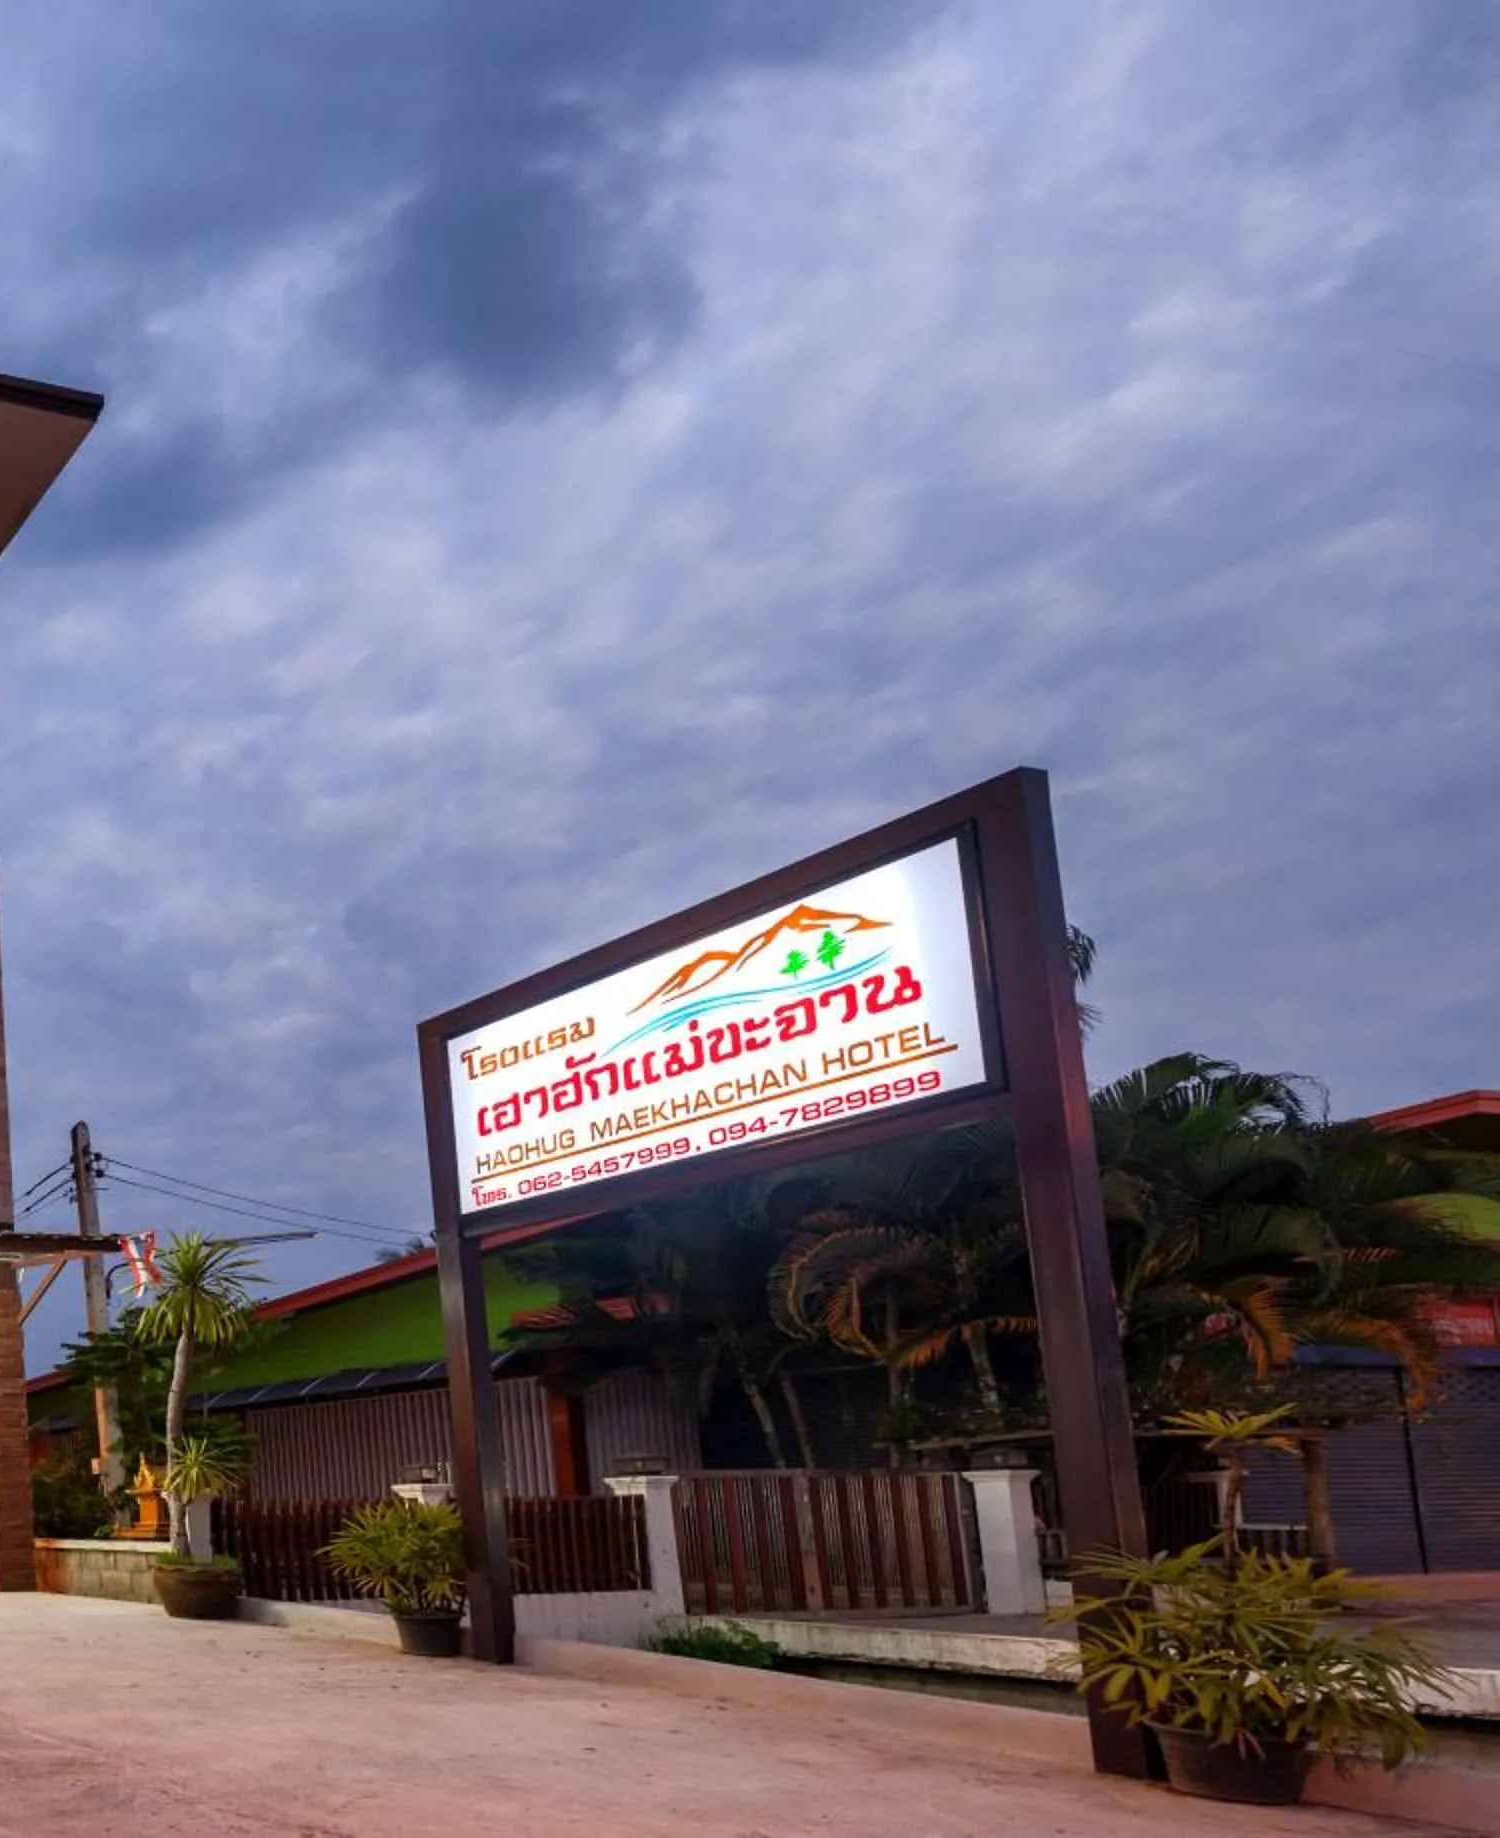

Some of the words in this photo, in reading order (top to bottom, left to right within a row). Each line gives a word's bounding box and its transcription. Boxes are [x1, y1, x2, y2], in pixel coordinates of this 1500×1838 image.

[461, 1016, 595, 1080] โรงแรม
[475, 1129, 575, 1174] HAOHUG
[589, 1058, 808, 1142] MAEKHACHAN
[821, 1022, 946, 1074] HOTEL
[708, 1071, 942, 1145] 094-7829899
